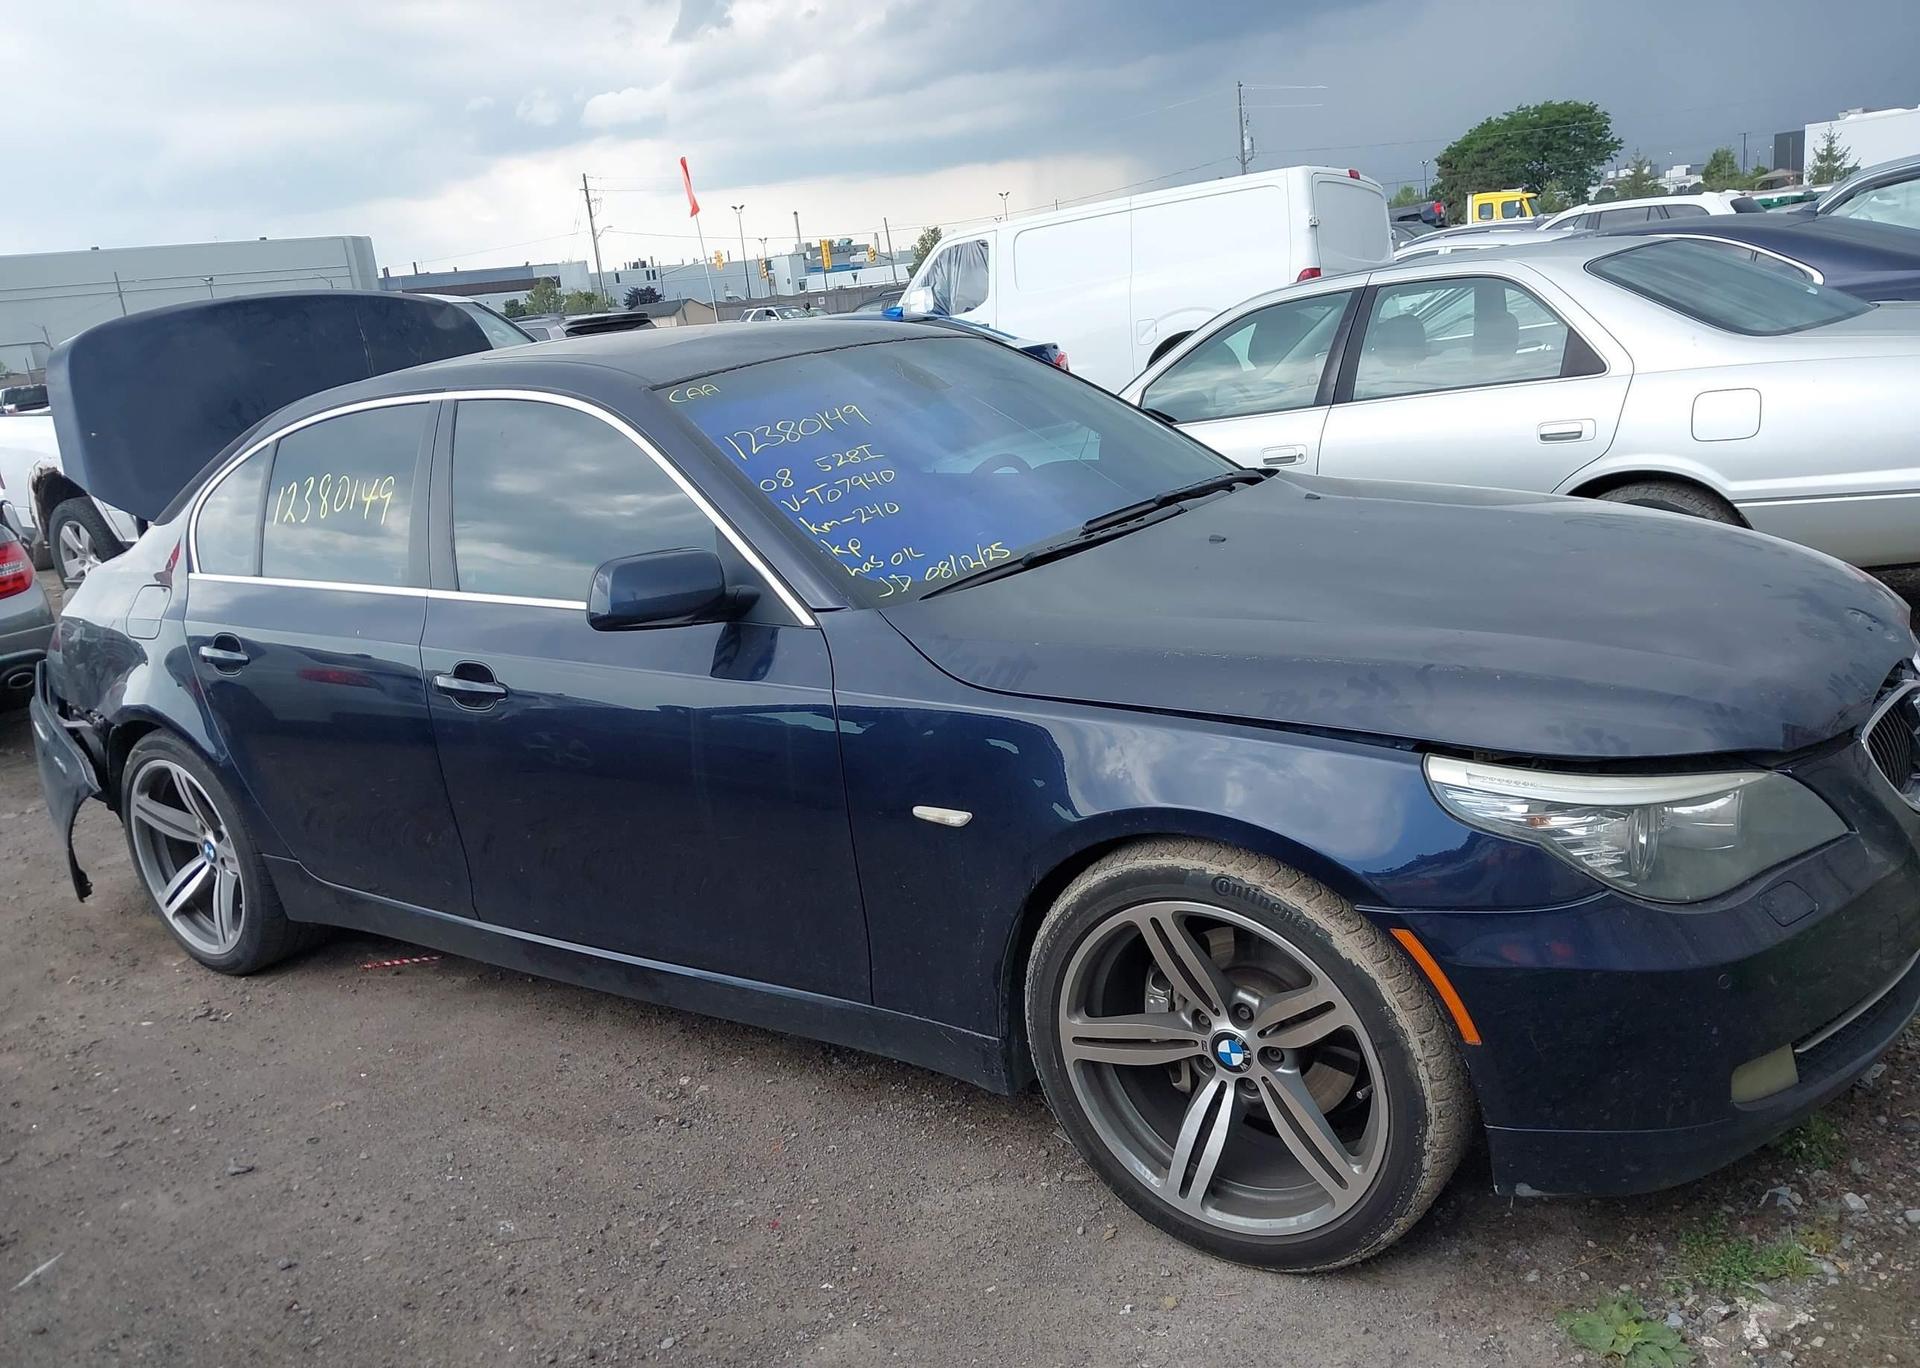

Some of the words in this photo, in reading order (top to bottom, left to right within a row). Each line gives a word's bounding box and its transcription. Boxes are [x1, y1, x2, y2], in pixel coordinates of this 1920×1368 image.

[669, 383, 721, 402] CAA
[723, 404, 872, 460] 12380149
[760, 468, 794, 491] 08
[273, 473, 395, 526] 12380149
[842, 555, 884, 576] has
[924, 542, 1011, 581] 08/12/25
